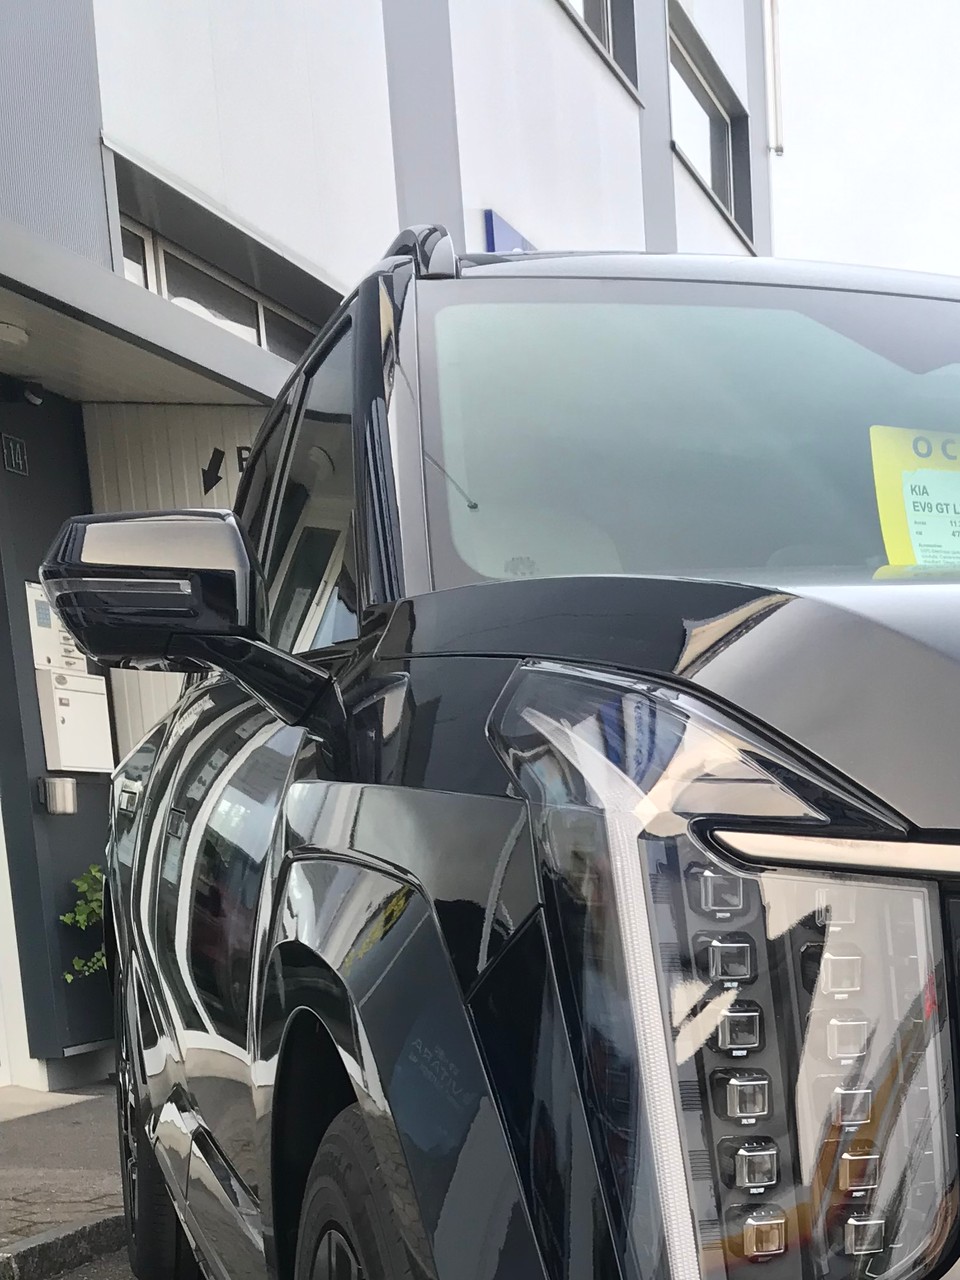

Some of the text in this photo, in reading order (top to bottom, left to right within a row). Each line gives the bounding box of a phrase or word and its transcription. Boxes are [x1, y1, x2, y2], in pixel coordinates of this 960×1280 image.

[9, 440, 23, 470] 14
[910, 484, 930, 496] KIA
[912, 501, 933, 513] EV9
[935, 502, 950, 514] GT
